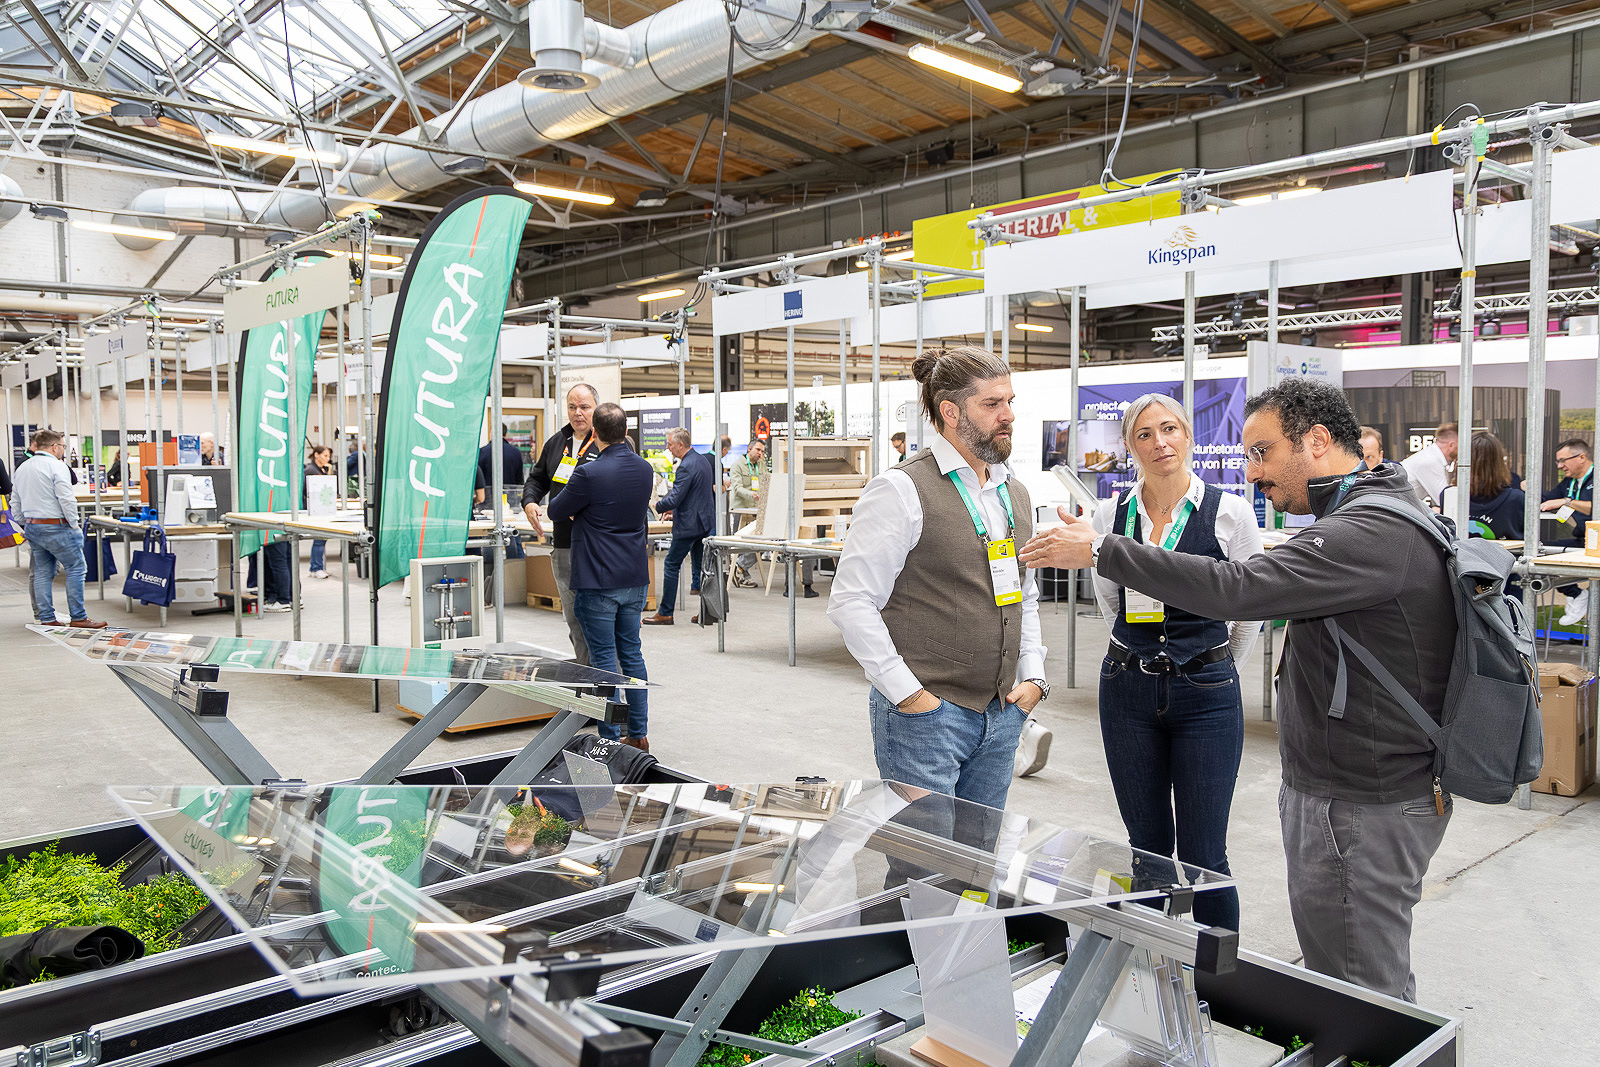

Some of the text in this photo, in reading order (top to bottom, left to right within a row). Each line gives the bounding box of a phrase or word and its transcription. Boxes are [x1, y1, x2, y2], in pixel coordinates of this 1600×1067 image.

[1083, 206, 1098, 226] &
[1148, 245, 1216, 265] Kingspan
[266, 286, 299, 311] FUTURA
[784, 308, 803, 318] HERING
[409, 263, 484, 497] FUTURA
[257, 316, 301, 488] FUTUR
